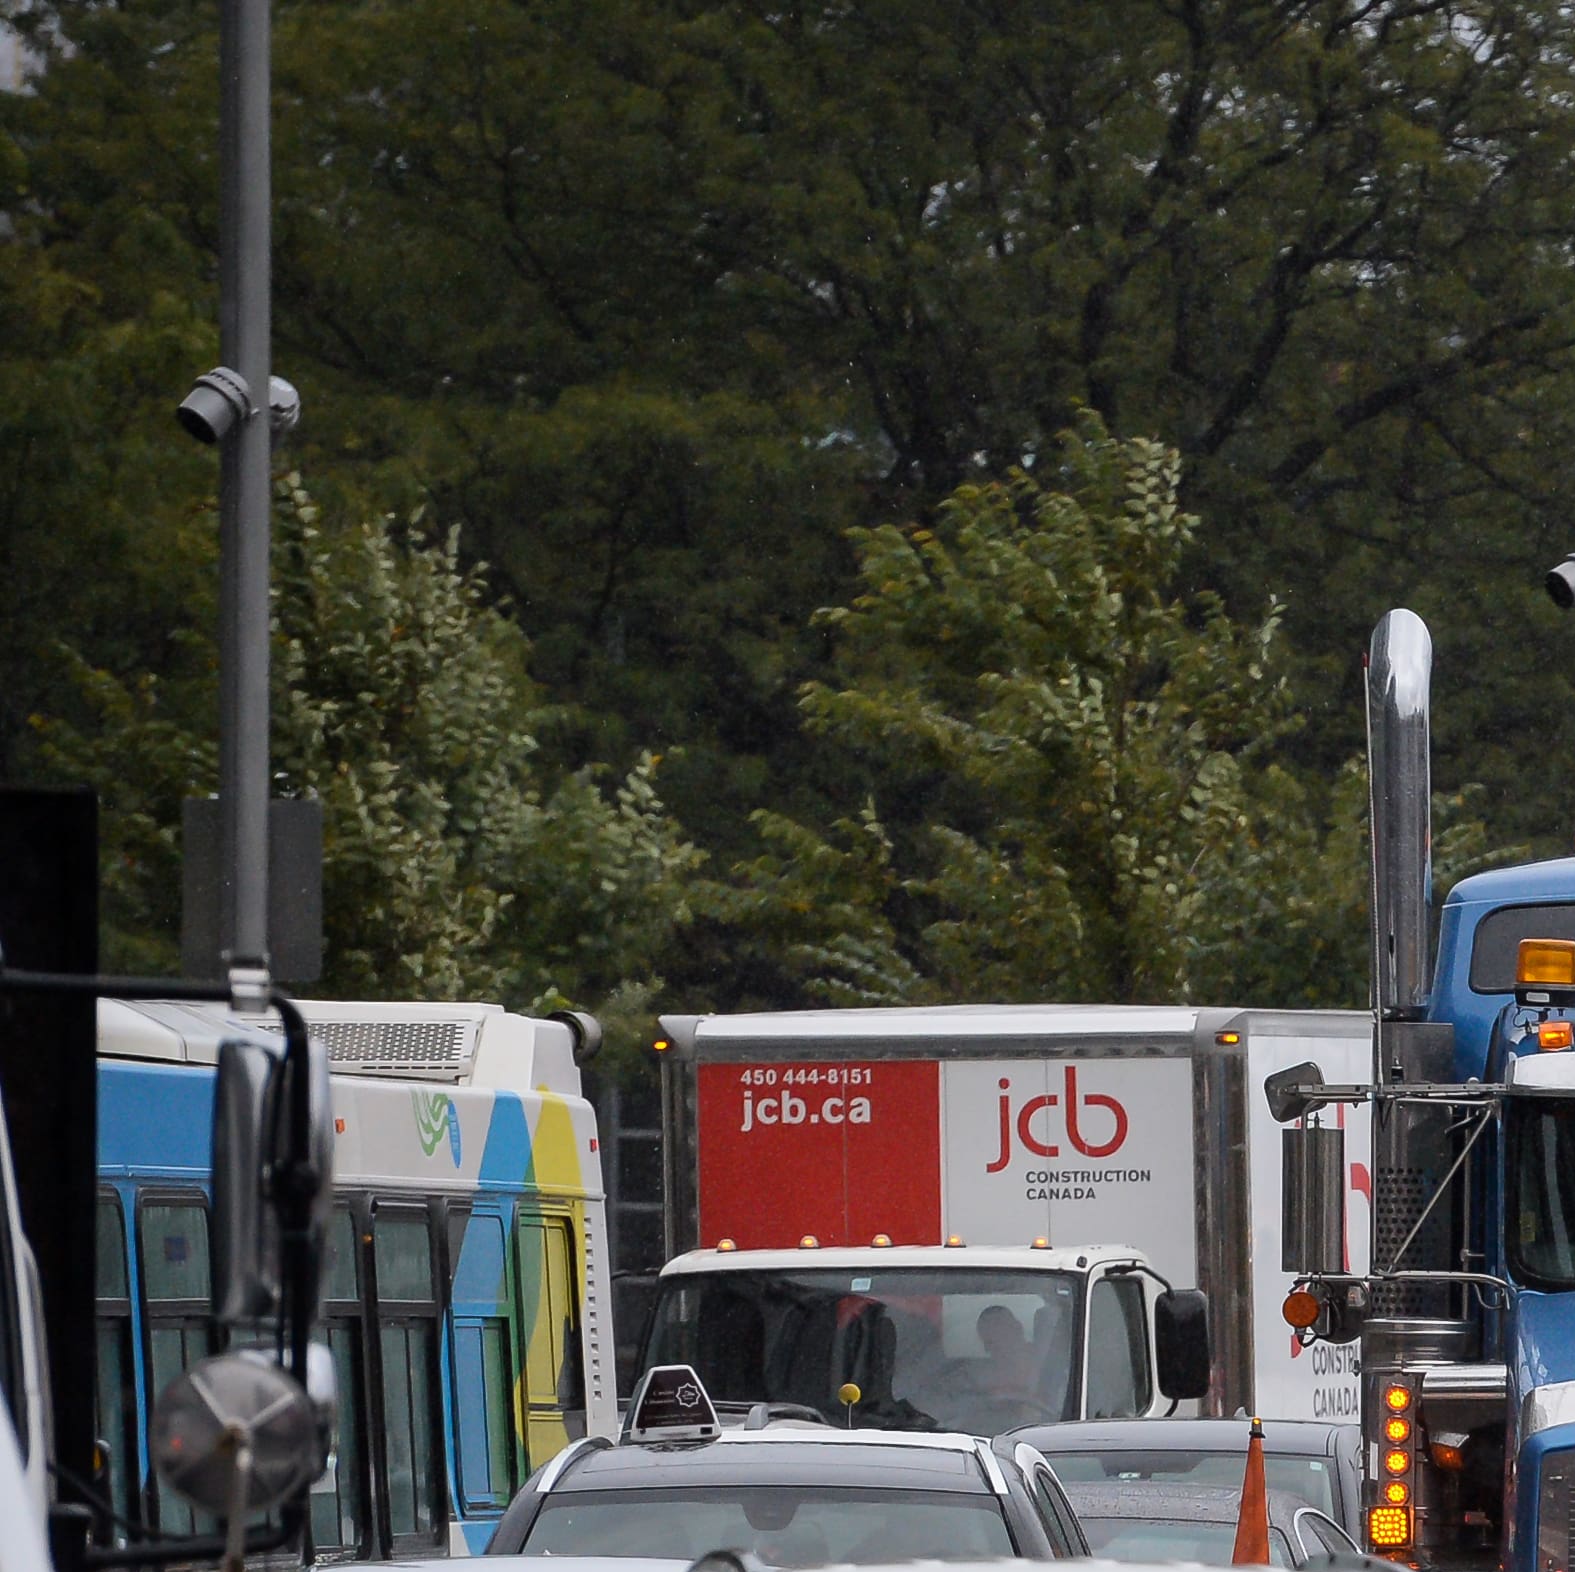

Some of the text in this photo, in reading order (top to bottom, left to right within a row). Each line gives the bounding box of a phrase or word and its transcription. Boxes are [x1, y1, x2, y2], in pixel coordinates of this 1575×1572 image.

[740, 1067, 872, 1085] 450 444-8151
[740, 1089, 871, 1132] jcb.ca
[986, 1065, 1128, 1174] jcb
[1025, 1169, 1151, 1184] CONSTRUCTION
[1026, 1187, 1096, 1200] CANADA
[1313, 1386, 1359, 1418] CANADA
